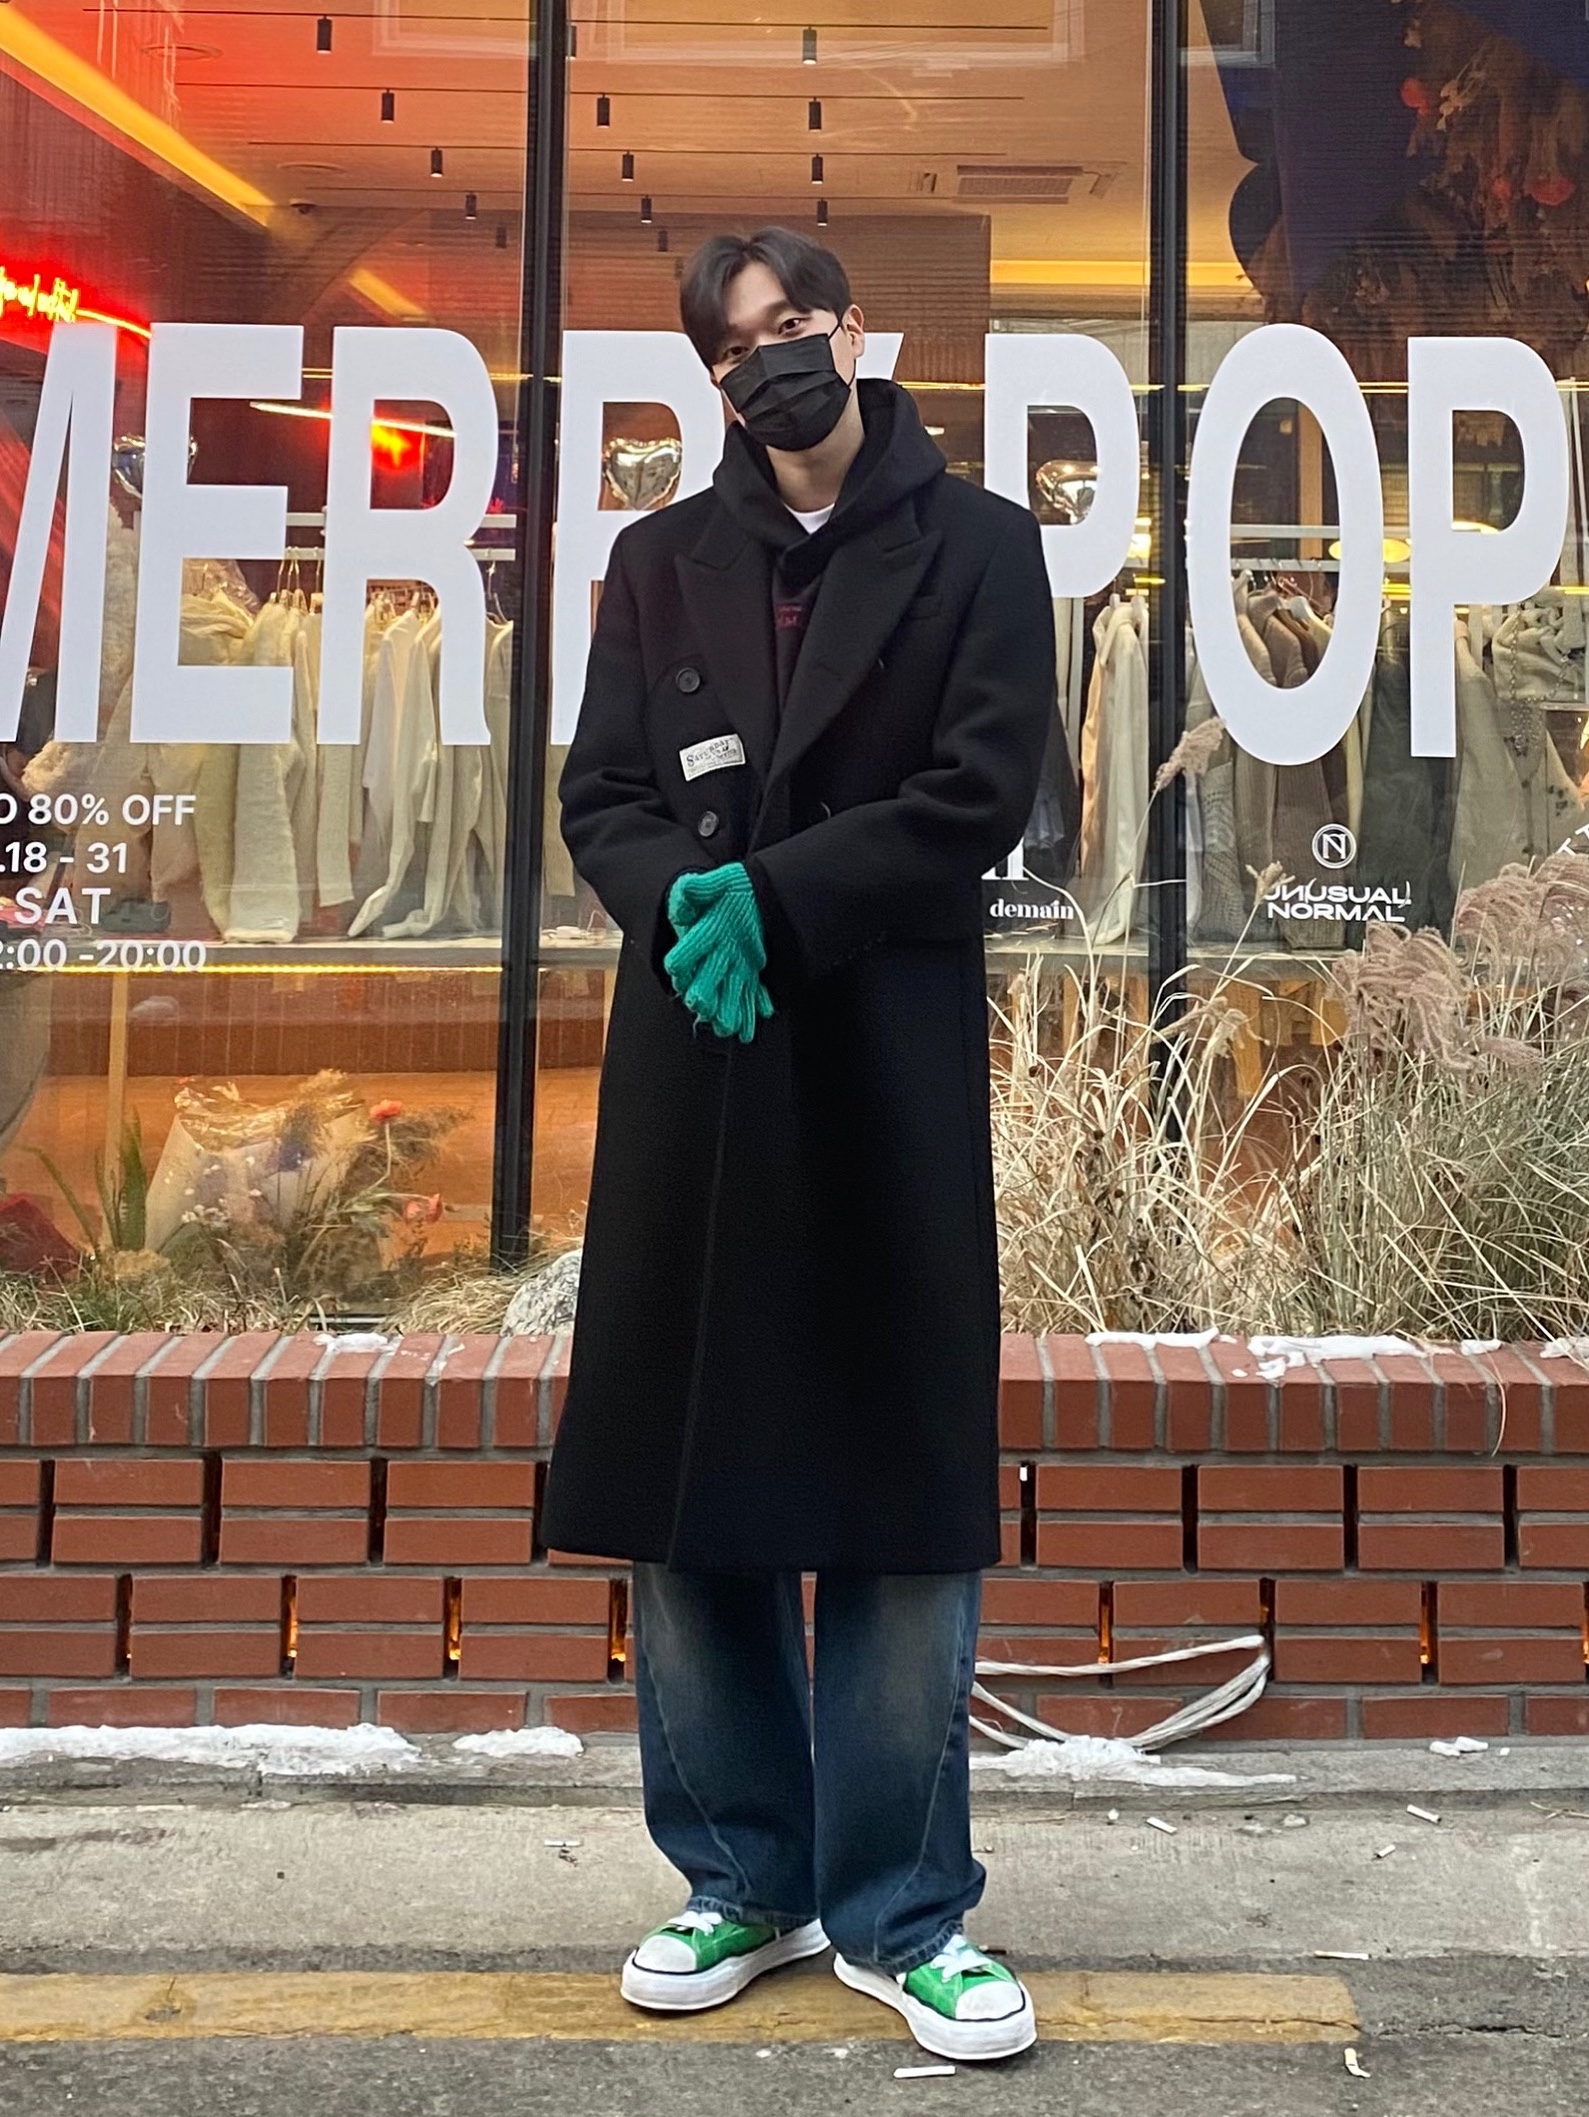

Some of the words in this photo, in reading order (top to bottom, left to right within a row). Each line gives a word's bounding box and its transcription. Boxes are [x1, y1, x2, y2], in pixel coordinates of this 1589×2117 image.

[0, 322, 904, 745] ERR
[984, 322, 1569, 766] POP
[28, 793, 109, 826] 80%
[122, 794, 197, 826] OFF
[86, 842, 127, 874] 31
[14, 887, 111, 925] SAT
[989, 898, 1075, 920] demain
[1268, 902, 1406, 923] NORMAL
[0, 938, 67, 972] :00
